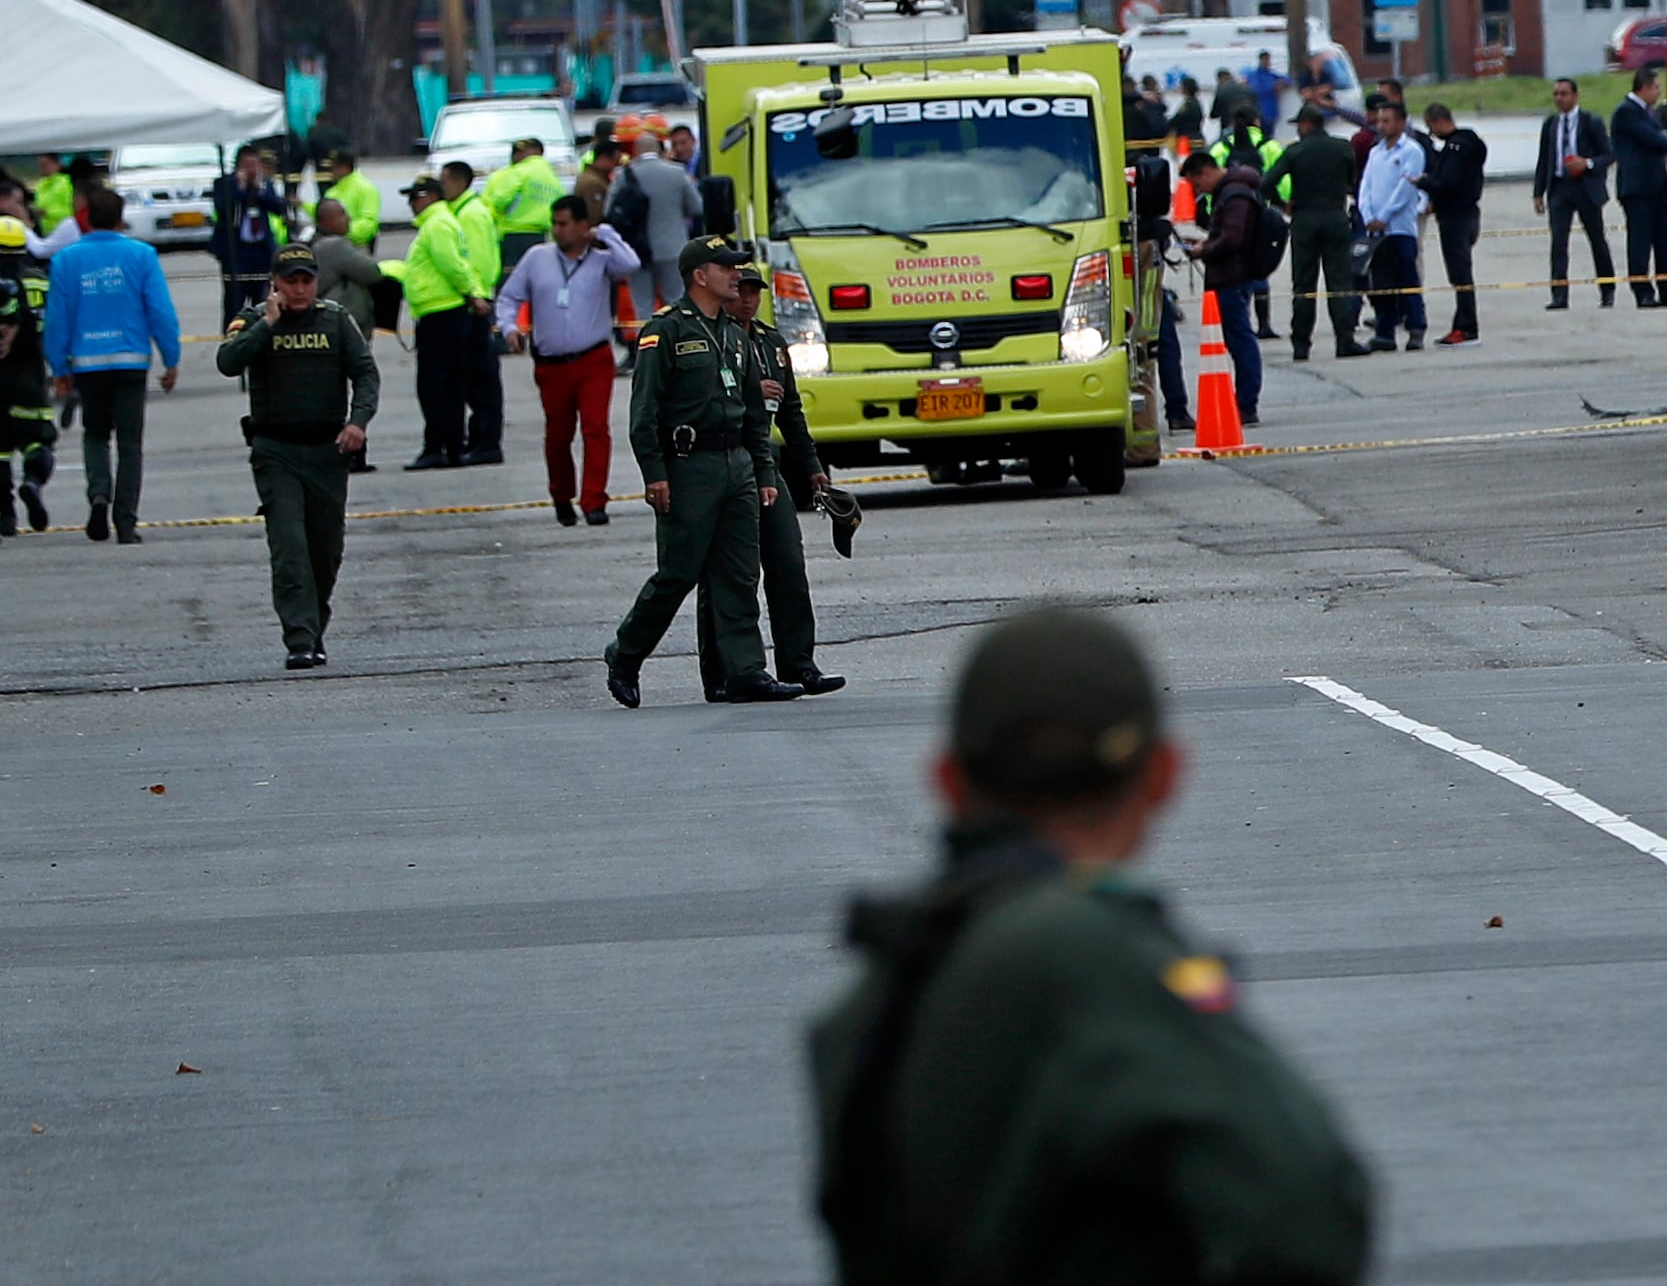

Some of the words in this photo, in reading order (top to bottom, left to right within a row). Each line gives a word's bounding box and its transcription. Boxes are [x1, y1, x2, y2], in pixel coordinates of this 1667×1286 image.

[895, 255, 981, 270] BOMBEROS
[887, 272, 995, 287] VOLUNTARIOS
[892, 292, 956, 305] BOGOTA
[961, 289, 990, 302] D.C.
[272, 333, 330, 350] POLICIA
